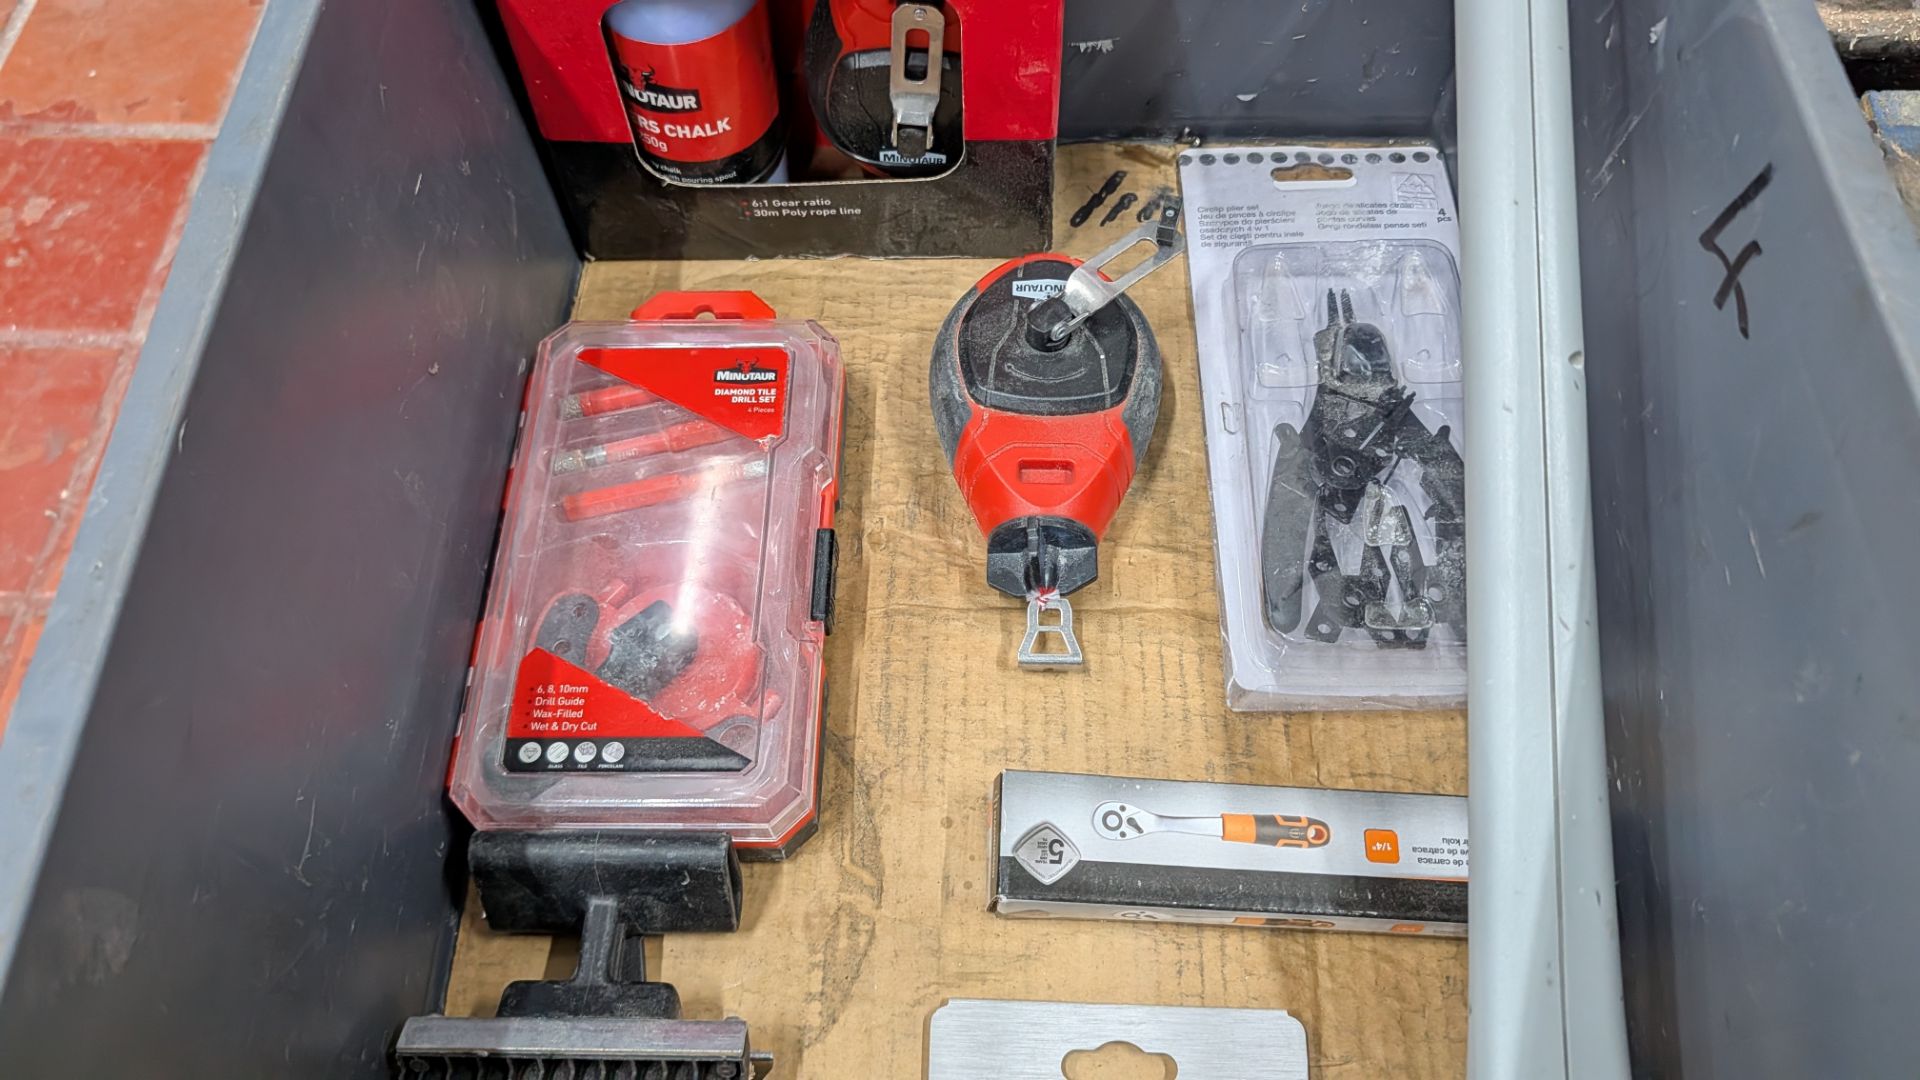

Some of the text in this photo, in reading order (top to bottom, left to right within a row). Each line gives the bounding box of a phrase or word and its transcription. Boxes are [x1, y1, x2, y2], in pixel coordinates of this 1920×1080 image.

[633, 111, 732, 139] RS CHALK
[681, 176, 714, 184] pouring
[714, 171, 737, 183] spout
[752, 198, 832, 208] 6:1 Gear ratio
[754, 207, 861, 218] 30m Poly rope line
[1197, 206, 1224, 216] Circlip
[1226, 205, 1244, 213] plier
[1438, 208, 1447, 216] 4
[1254, 231, 1282, 240] pentru
[716, 370, 776, 381] MINOTAUR
[714, 388, 777, 396] DIAMOND TILE
[537, 684, 589, 694] 6, 8, 10mm
[535, 696, 585, 706] Drill Guide
[533, 709, 584, 718] Wax-Filled
[531, 721, 598, 733] Wet & Dry Cut
[1048, 838, 1065, 865] 5
[1411, 846, 1445, 855] catraca
[1447, 848, 1459, 856] de
[1417, 857, 1451, 865] carraca
[1452, 859, 1464, 868] de
